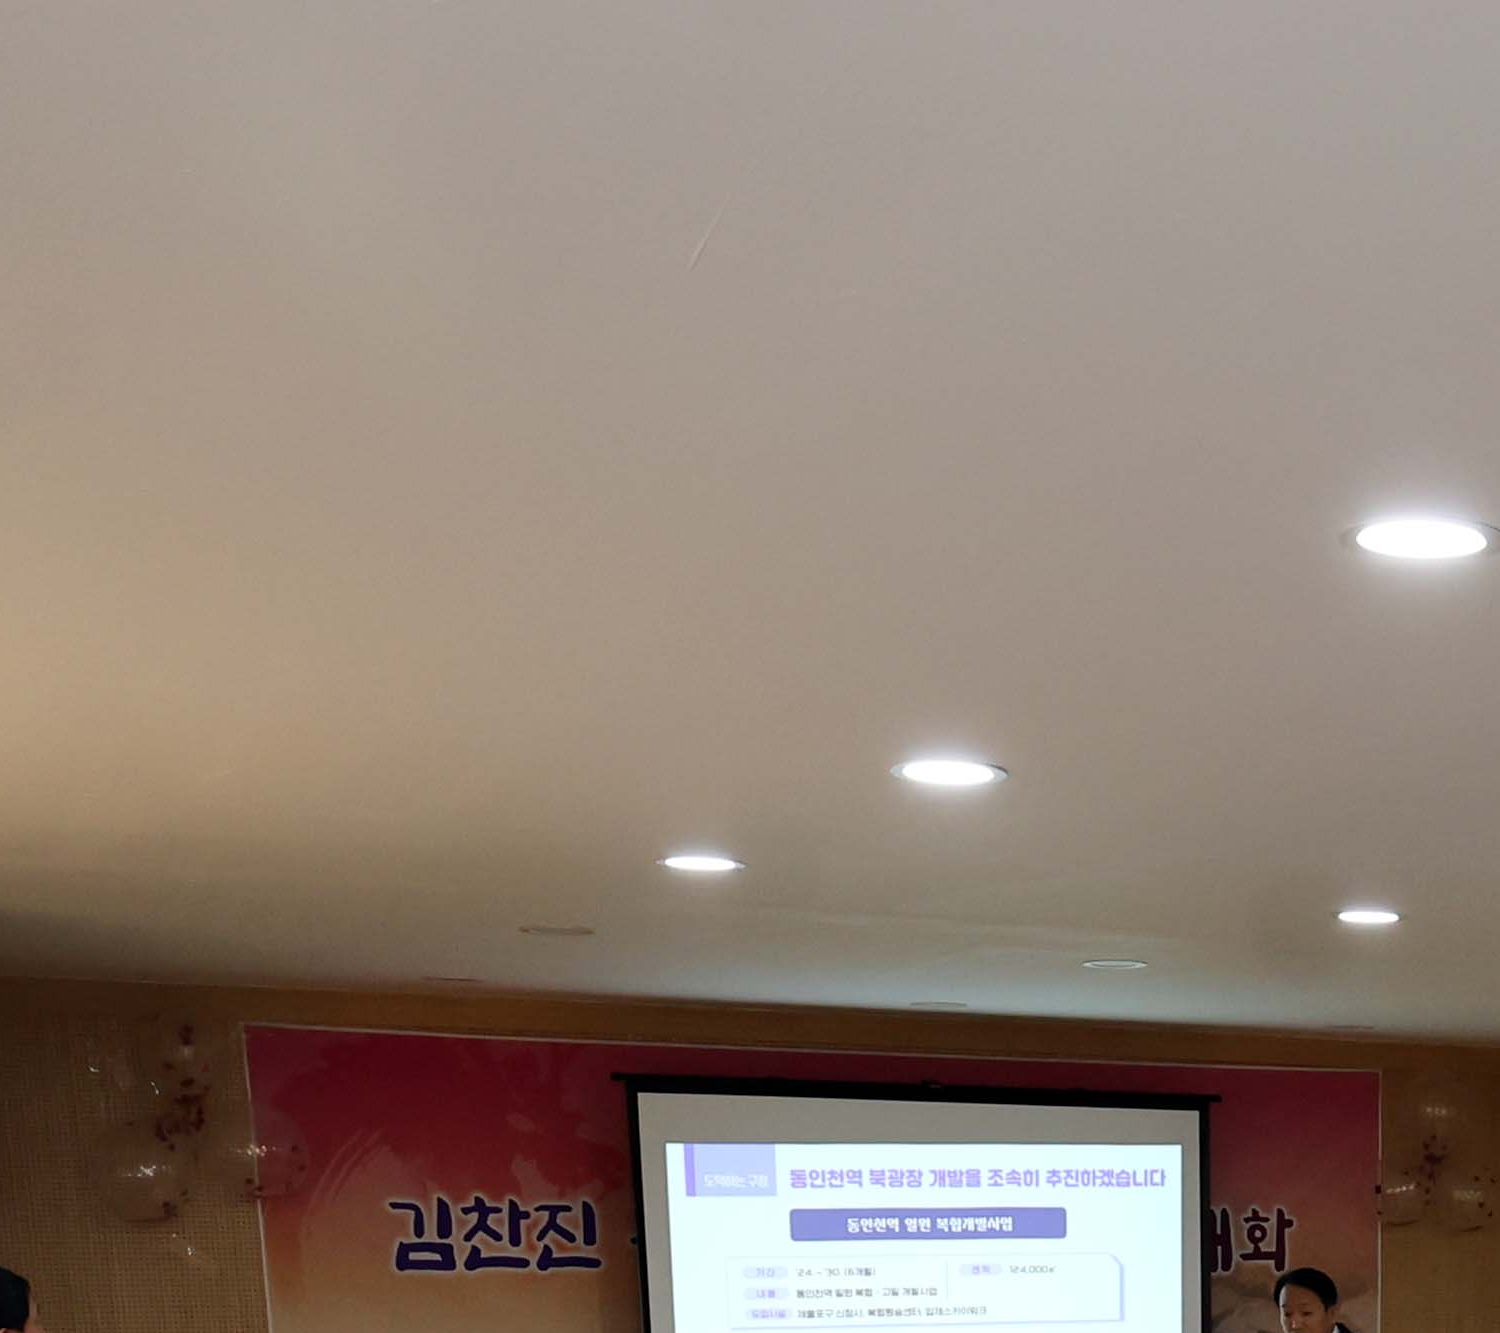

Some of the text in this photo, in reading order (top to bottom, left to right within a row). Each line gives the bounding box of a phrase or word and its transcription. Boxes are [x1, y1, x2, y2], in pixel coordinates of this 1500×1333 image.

[789, 1167, 1167, 1189] 동인천역 북광장 개발을 조속히 추진하겠습니다
[389, 1195, 603, 1272] 김찬진
[846, 1216, 900, 1233] 동인천역
[936, 1216, 1013, 1233] 복합개발사업
